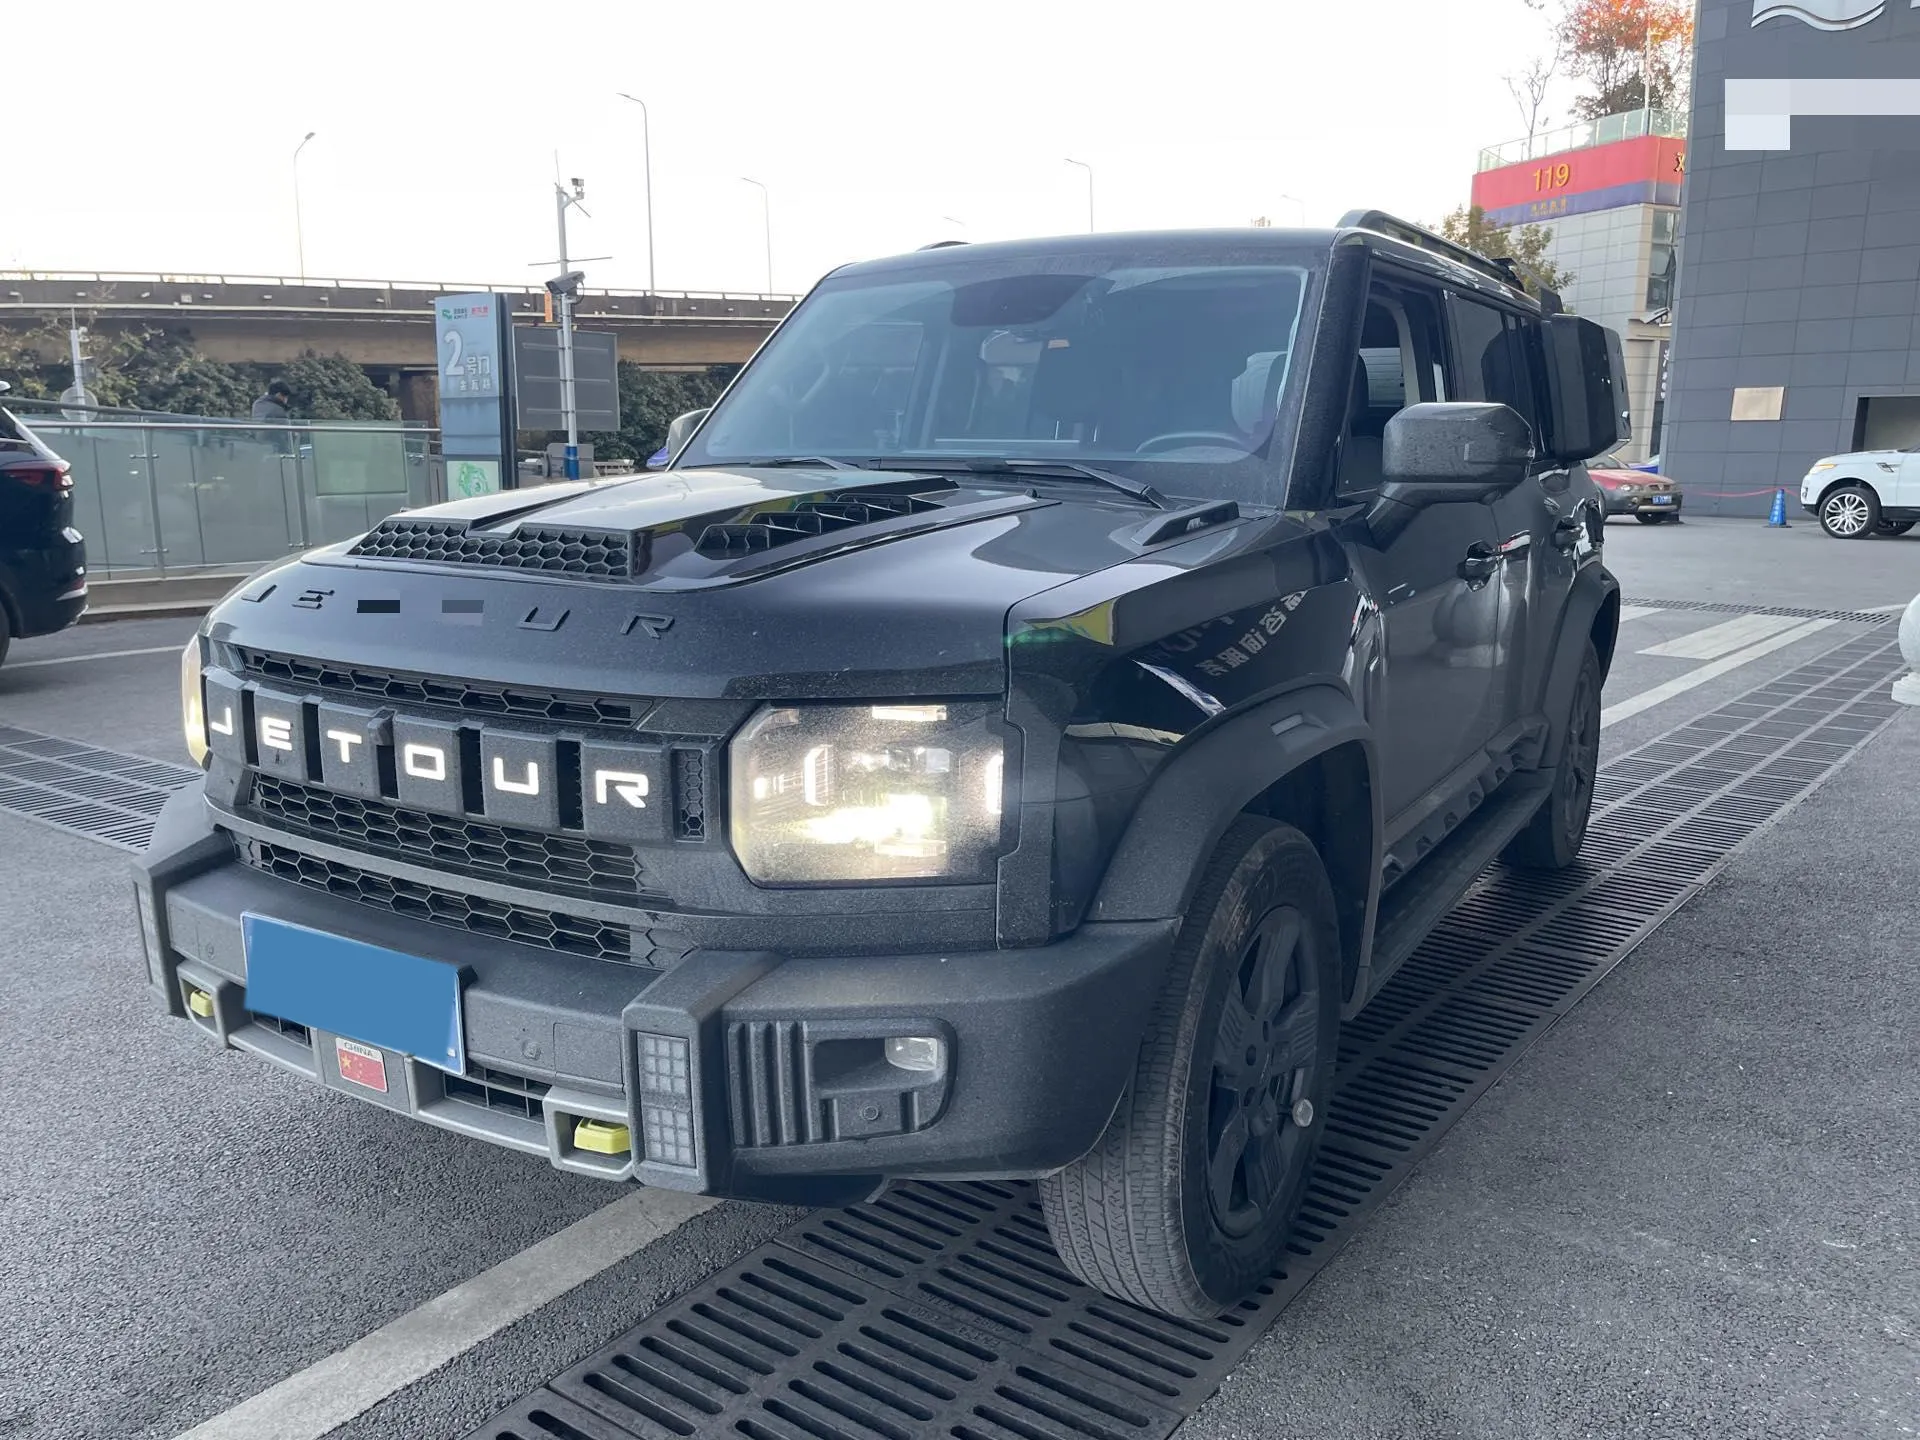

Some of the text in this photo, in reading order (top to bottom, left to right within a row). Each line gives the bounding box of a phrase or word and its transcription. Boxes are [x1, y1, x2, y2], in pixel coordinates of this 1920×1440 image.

[1533, 163, 1569, 192] 119
[241, 584, 676, 640] JEUR
[211, 707, 650, 808] JETOUR
[344, 1041, 373, 1057] CHINA
